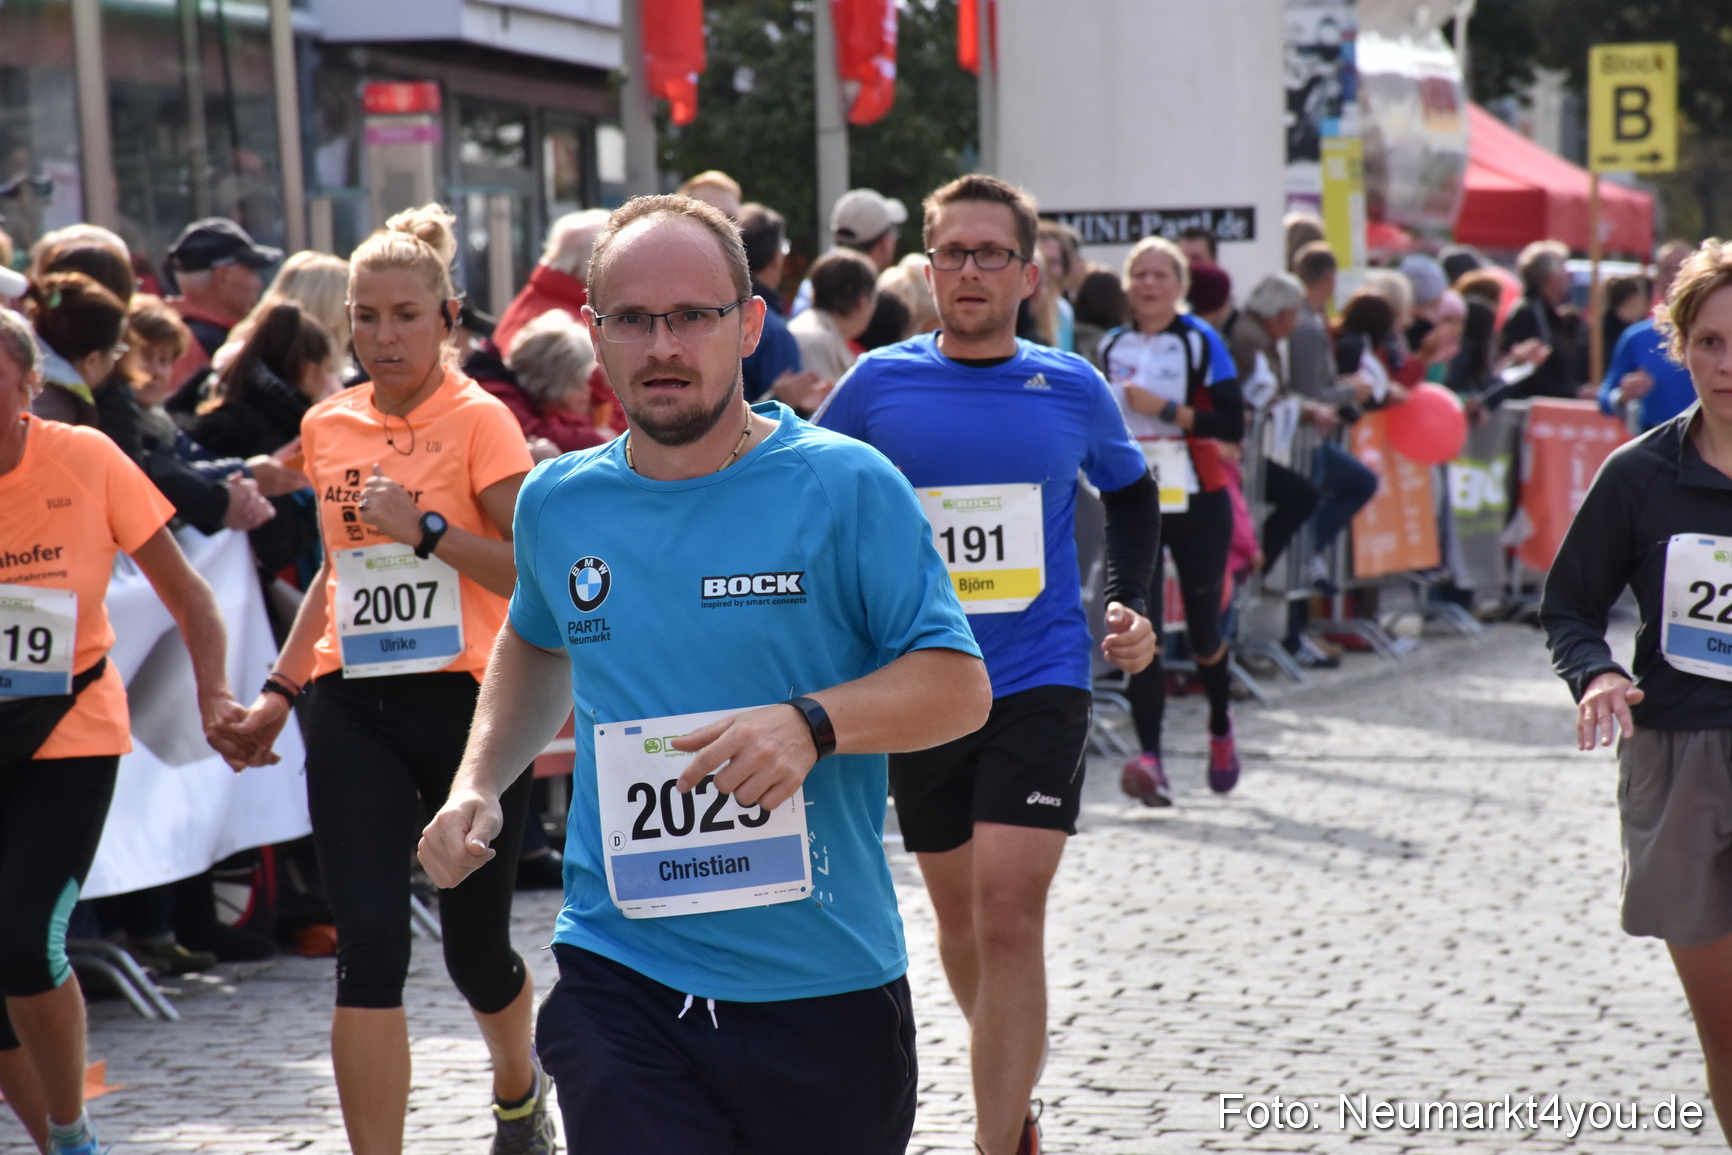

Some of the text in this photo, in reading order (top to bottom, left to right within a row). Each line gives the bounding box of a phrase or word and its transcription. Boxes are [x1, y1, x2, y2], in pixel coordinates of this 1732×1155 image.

[1615, 86, 1653, 142] B
[940, 524, 1004, 564] 191
[571, 558, 608, 577] BMW
[702, 573, 805, 599] BOCK
[958, 577, 995, 594] Björn
[353, 580, 439, 627] 2007
[701, 599, 732, 609] inspired
[734, 599, 744, 607] by
[772, 597, 808, 605] concepts
[568, 618, 610, 635] PARTL
[380, 637, 417, 653] Ulrike
[568, 631, 611, 645] Neumarkt
[658, 854, 751, 882] Christian
